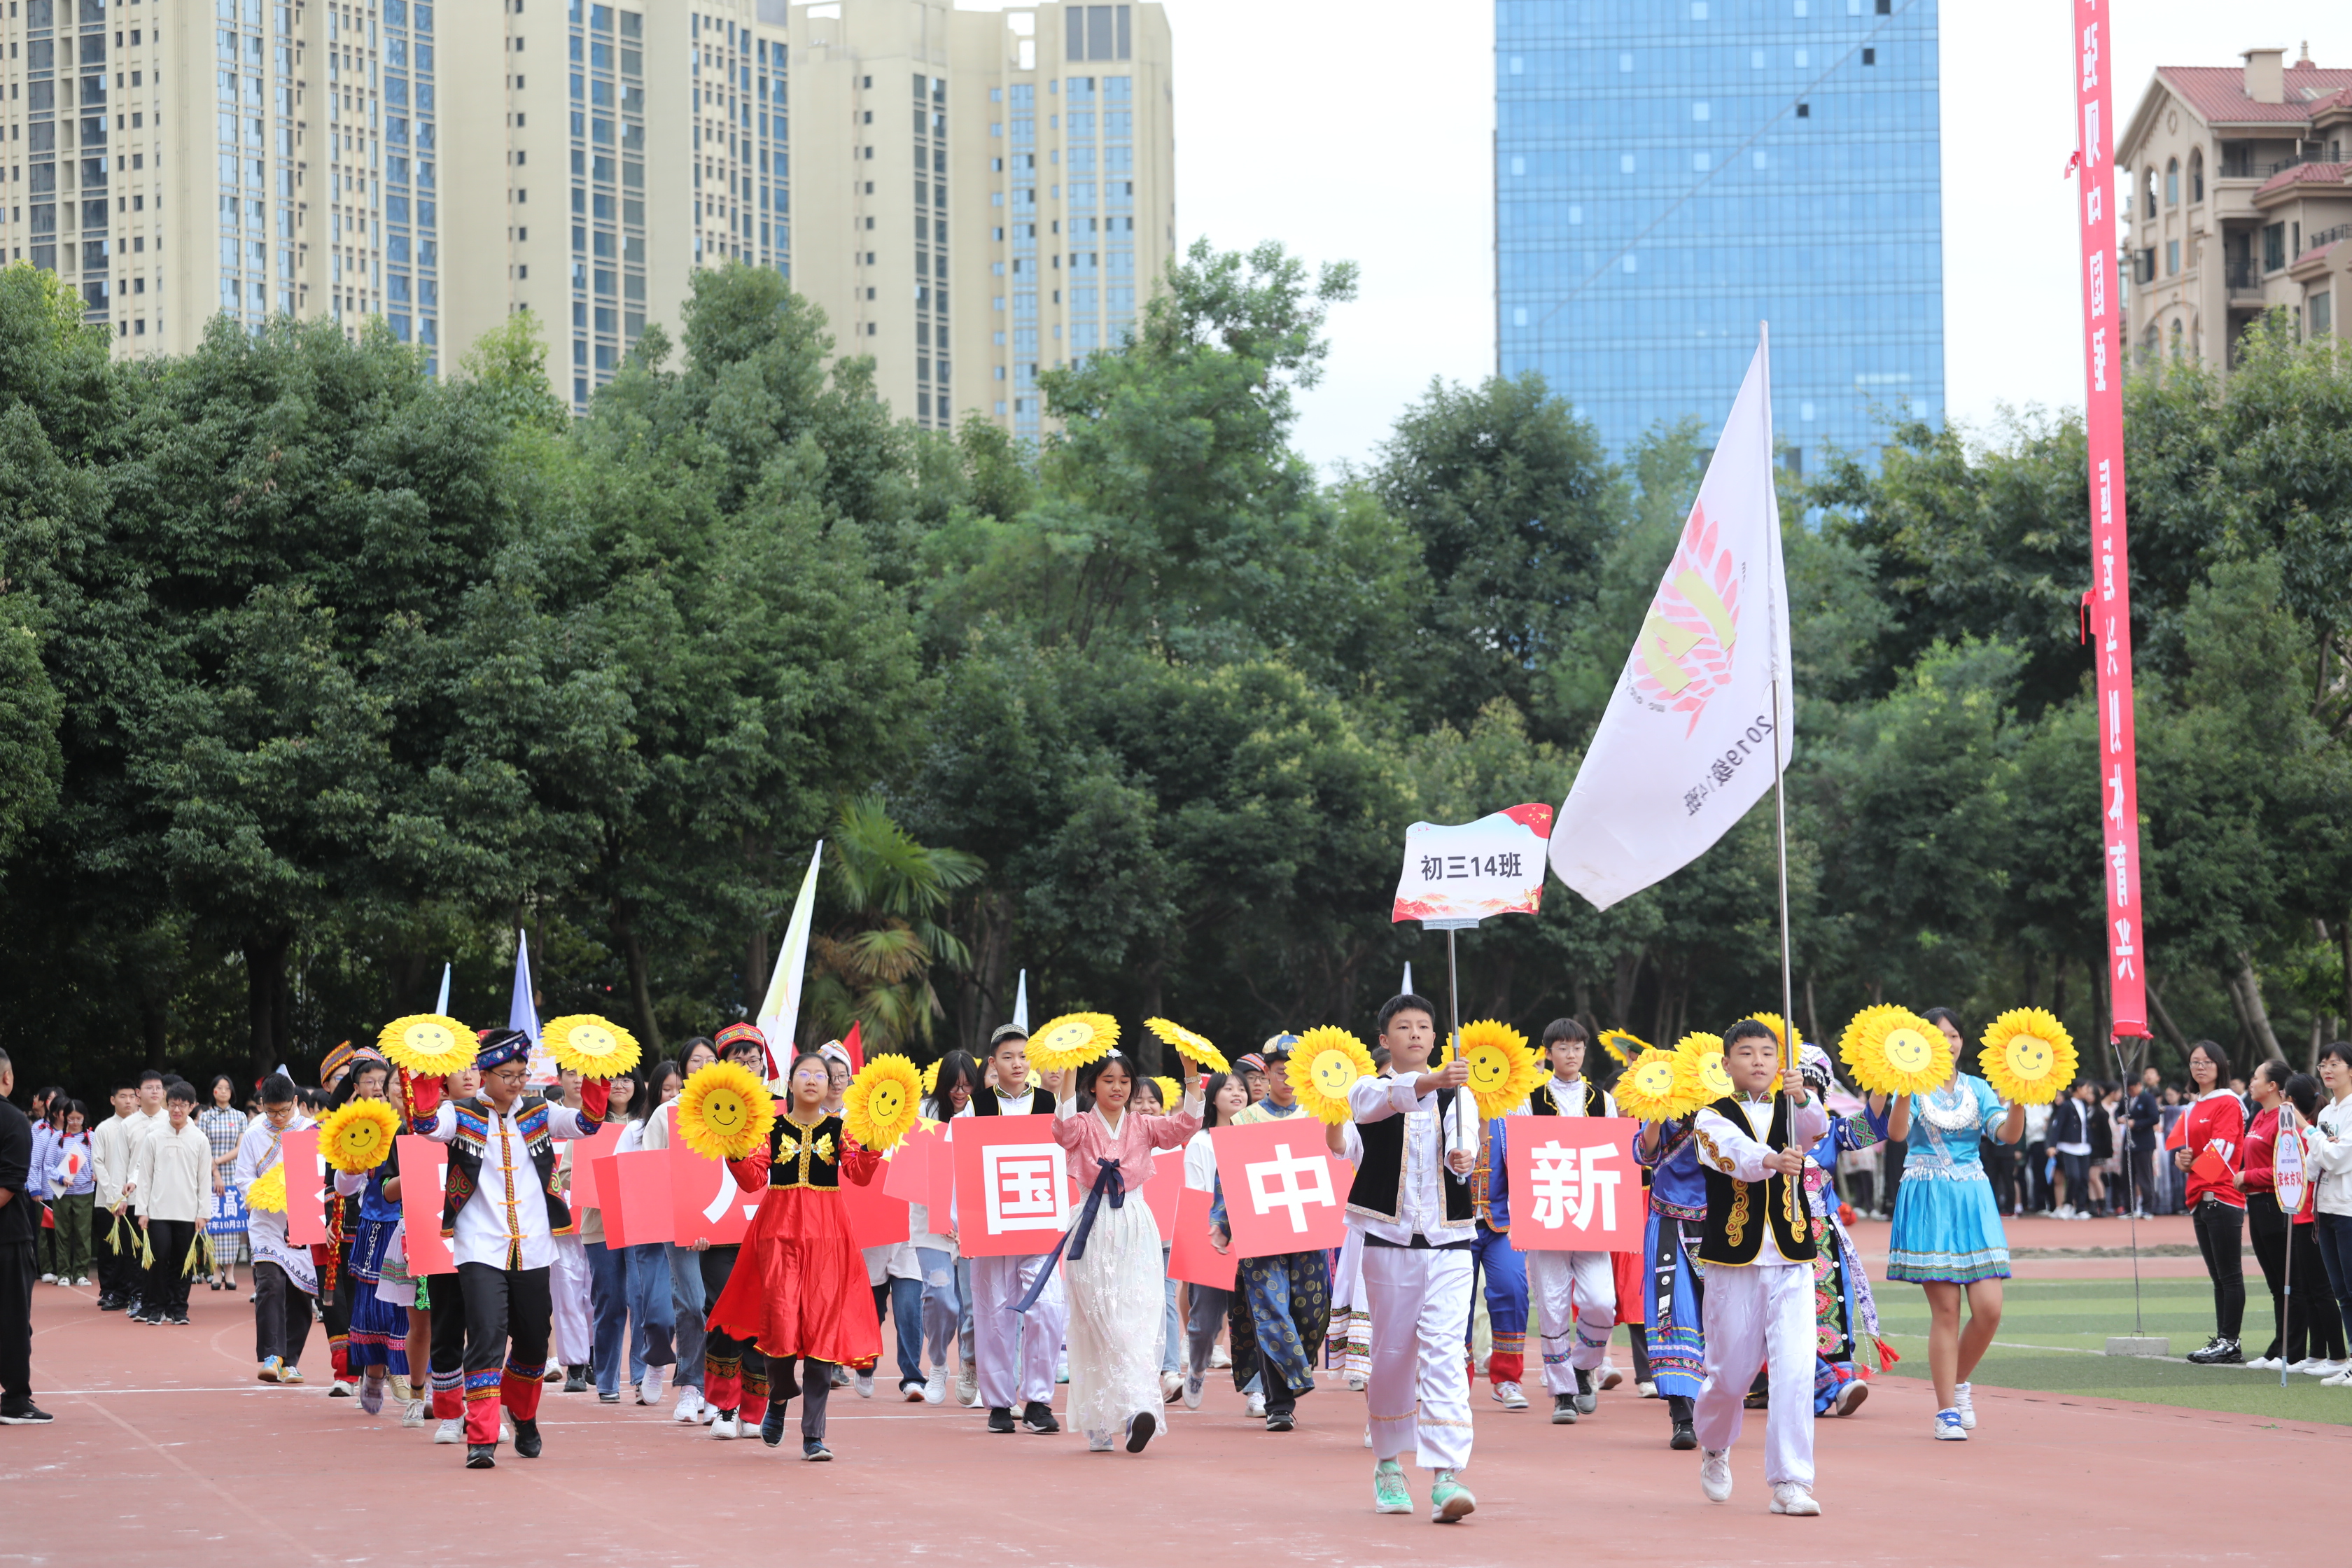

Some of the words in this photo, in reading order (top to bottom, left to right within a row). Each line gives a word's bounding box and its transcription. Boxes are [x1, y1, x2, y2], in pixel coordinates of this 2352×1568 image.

[1421, 851, 1522, 881] 初三14班
[528, 1048, 550, 1058] 之父
[982, 1143, 1070, 1235] 国
[1245, 1144, 1336, 1233] 中
[1530, 1140, 1621, 1232] 新
[2277, 1171, 2303, 1187] 家长方队
[211, 1189, 245, 1218] 复高
